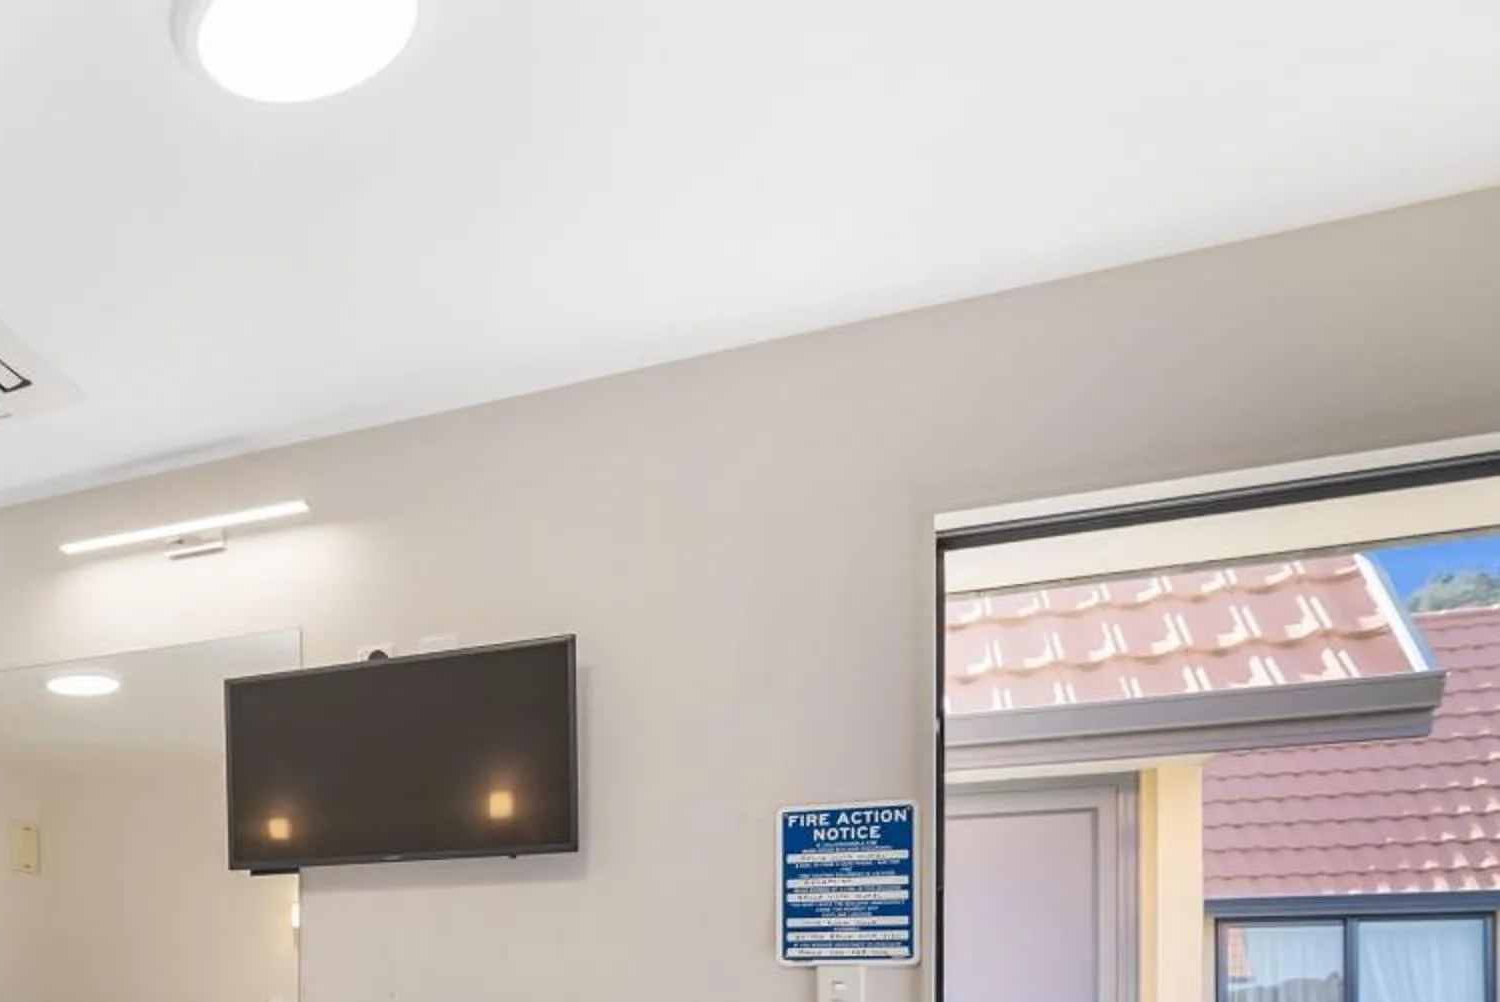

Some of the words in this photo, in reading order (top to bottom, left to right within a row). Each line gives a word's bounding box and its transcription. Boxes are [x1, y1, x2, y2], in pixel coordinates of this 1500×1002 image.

[787, 814, 830, 828] FIRE
[836, 810, 907, 825] ACTION
[813, 825, 881, 841] NOTICE
